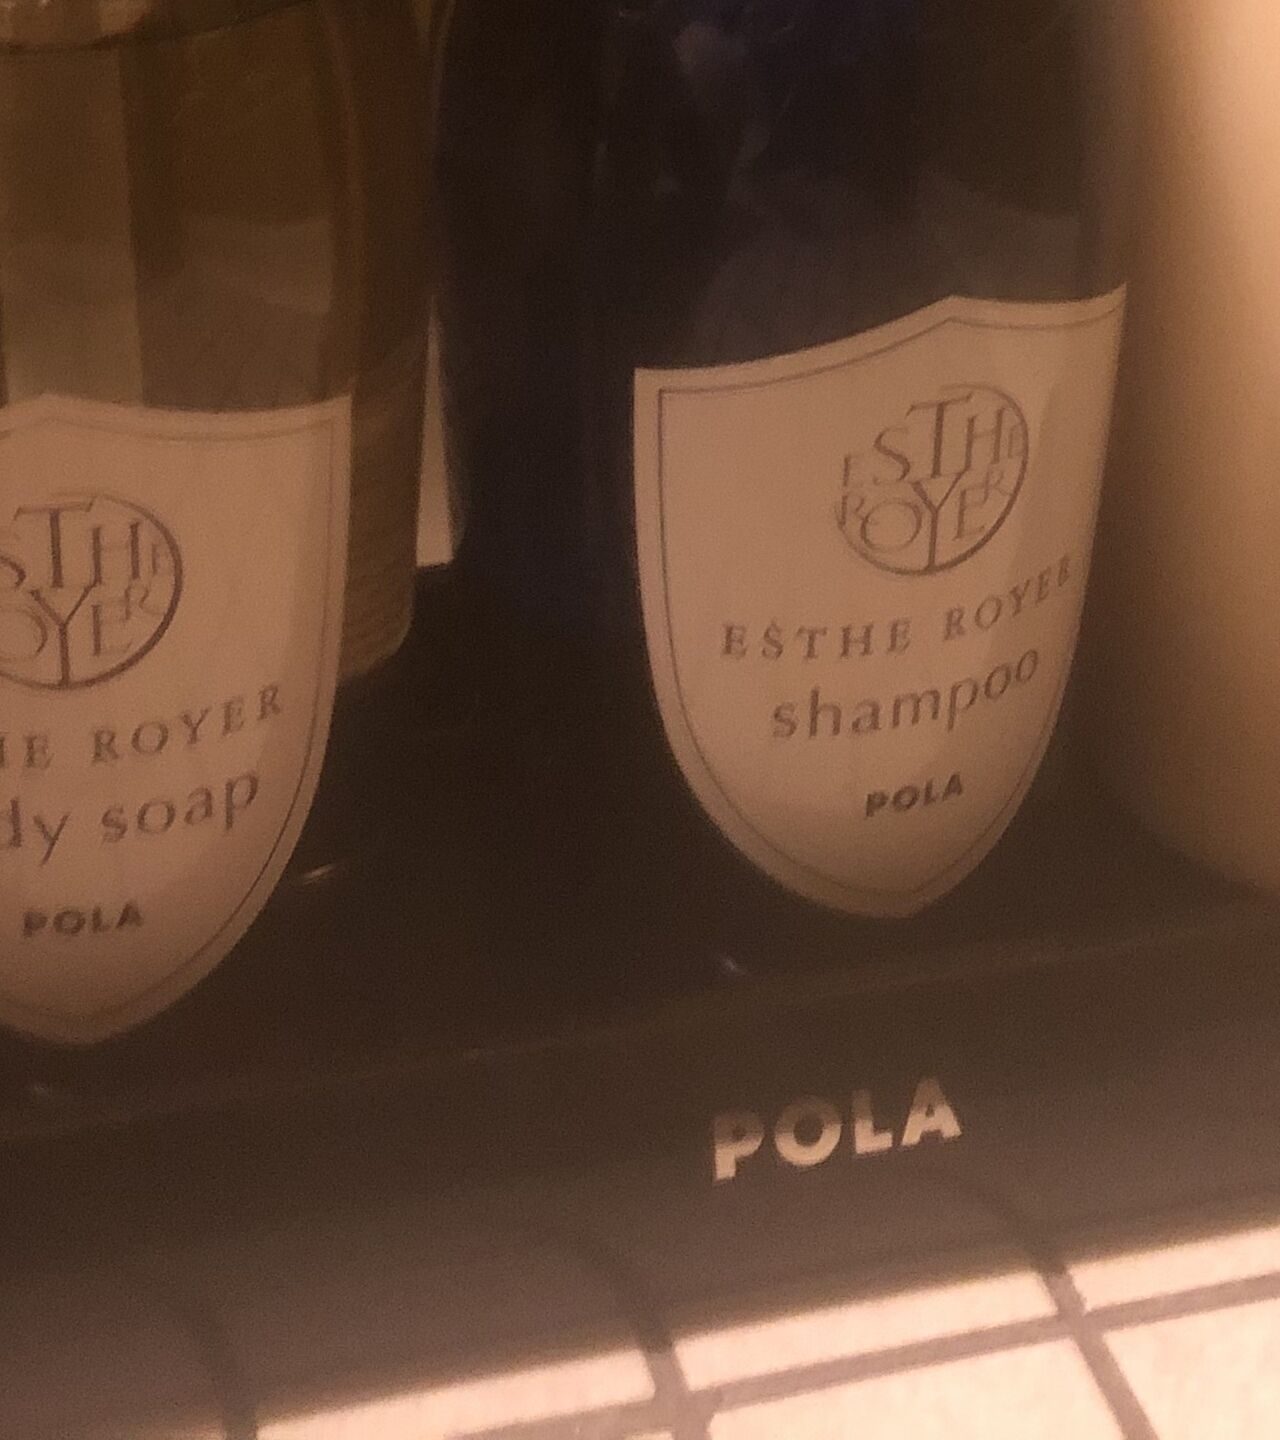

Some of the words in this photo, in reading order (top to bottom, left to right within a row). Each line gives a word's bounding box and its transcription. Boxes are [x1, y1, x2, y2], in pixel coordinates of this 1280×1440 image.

[722, 617, 912, 659] ESTHE
[943, 555, 1071, 642] ROYER
[90, 683, 283, 762] ROYER
[772, 648, 1038, 739] shampoo
[101, 769, 260, 844] soap
[864, 773, 965, 818] POLA
[22, 900, 144, 938] POLA
[713, 1078, 963, 1182] POLA
